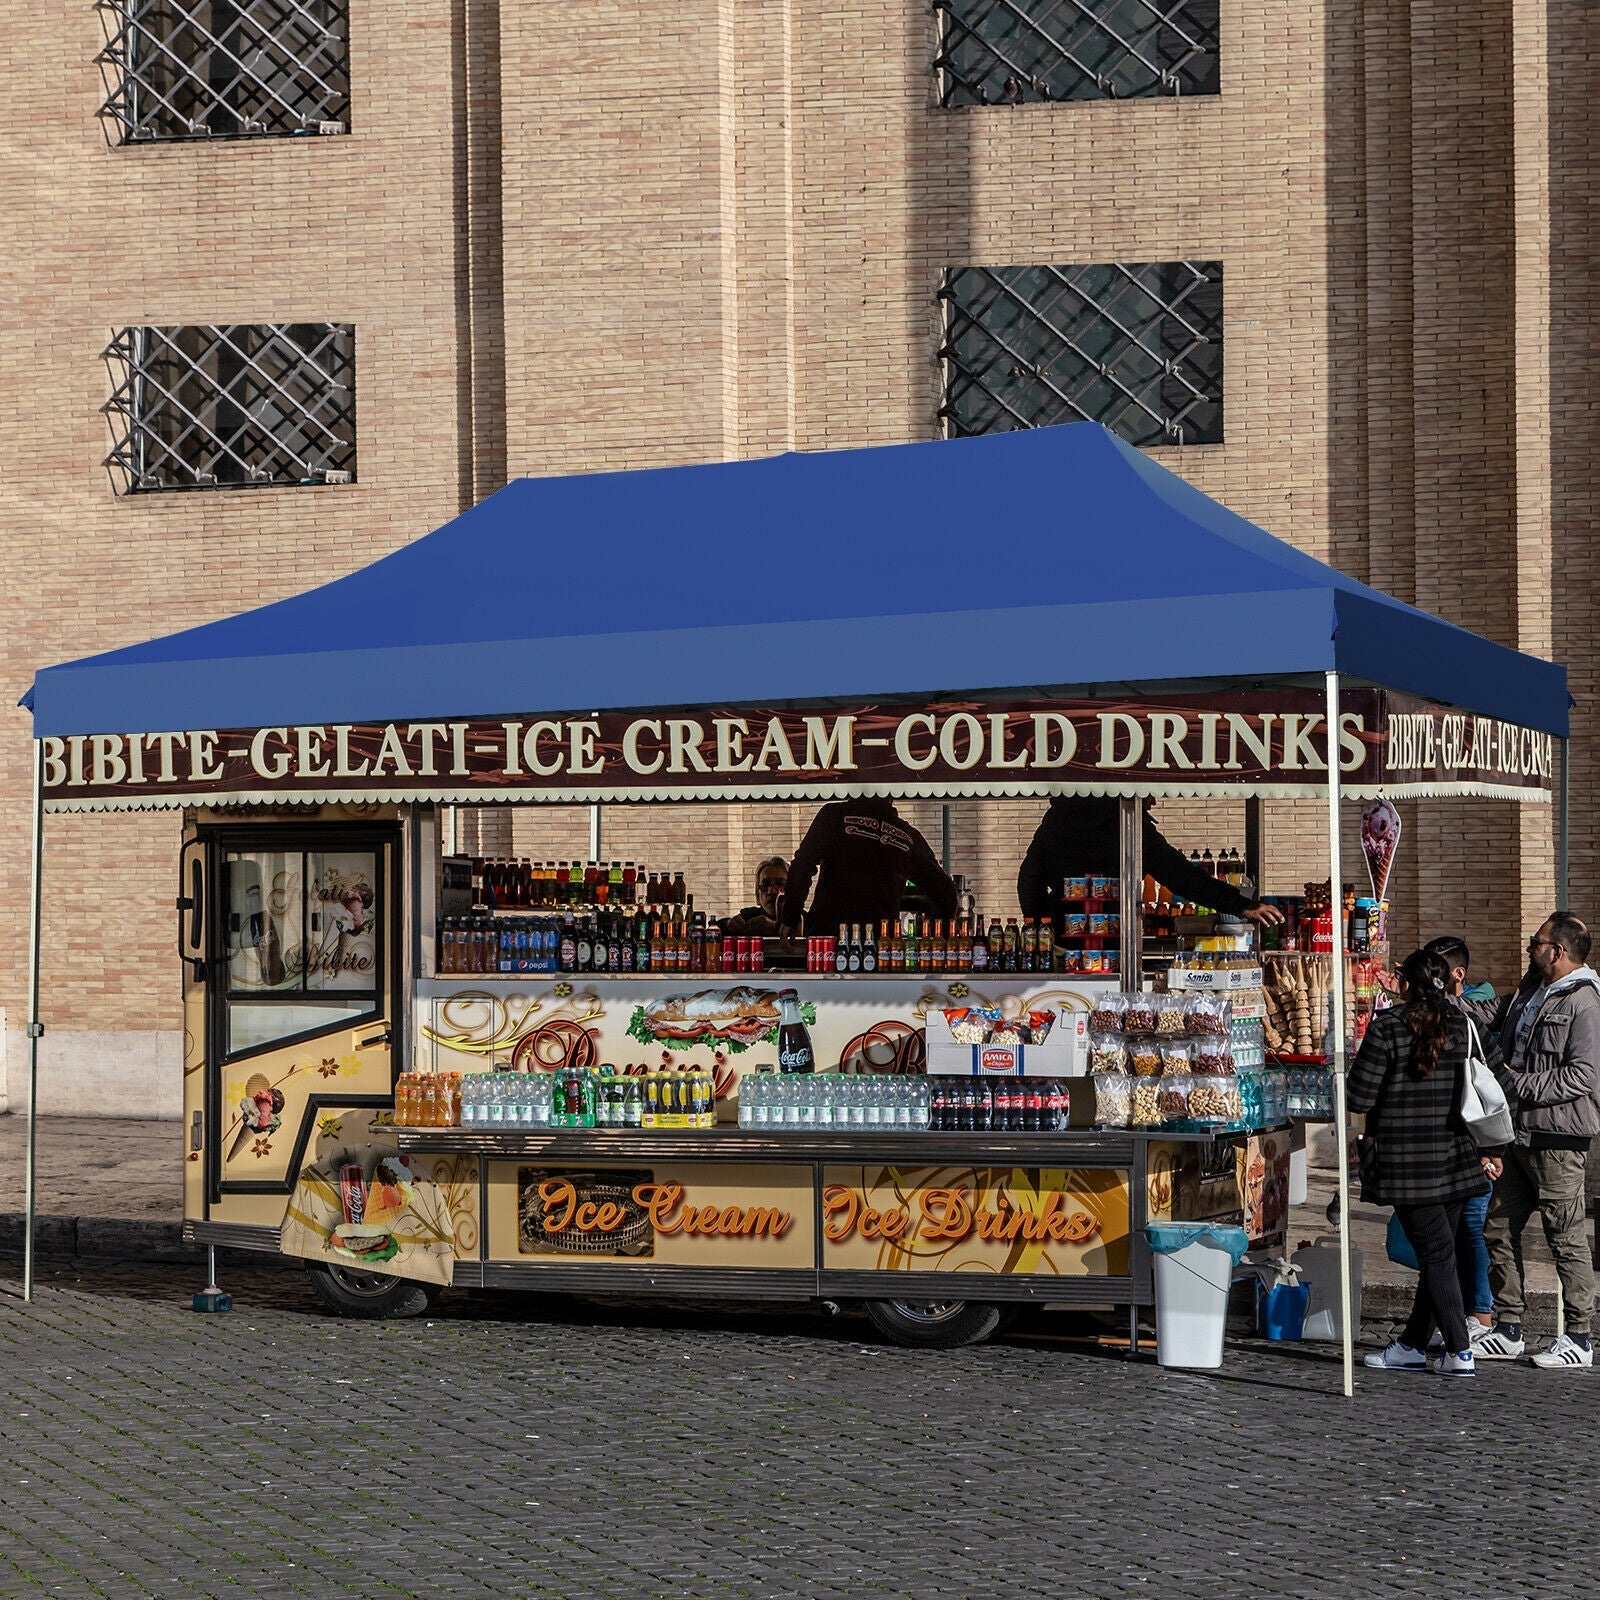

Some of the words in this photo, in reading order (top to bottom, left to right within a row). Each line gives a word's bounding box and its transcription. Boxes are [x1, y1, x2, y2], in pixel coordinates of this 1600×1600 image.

[43, 720, 606, 788] BIBITE-GELATI-ICE
[622, 712, 1078, 775] CREAM-COLD
[1095, 712, 1368, 773] DRINKS
[528, 961, 549, 970] pepsi
[983, 1053, 1013, 1061] AMICA
[537, 1177, 626, 1233] Ice
[631, 1179, 791, 1235] Cream
[822, 1183, 910, 1241] Ice
[918, 1185, 1098, 1242] Drinks
